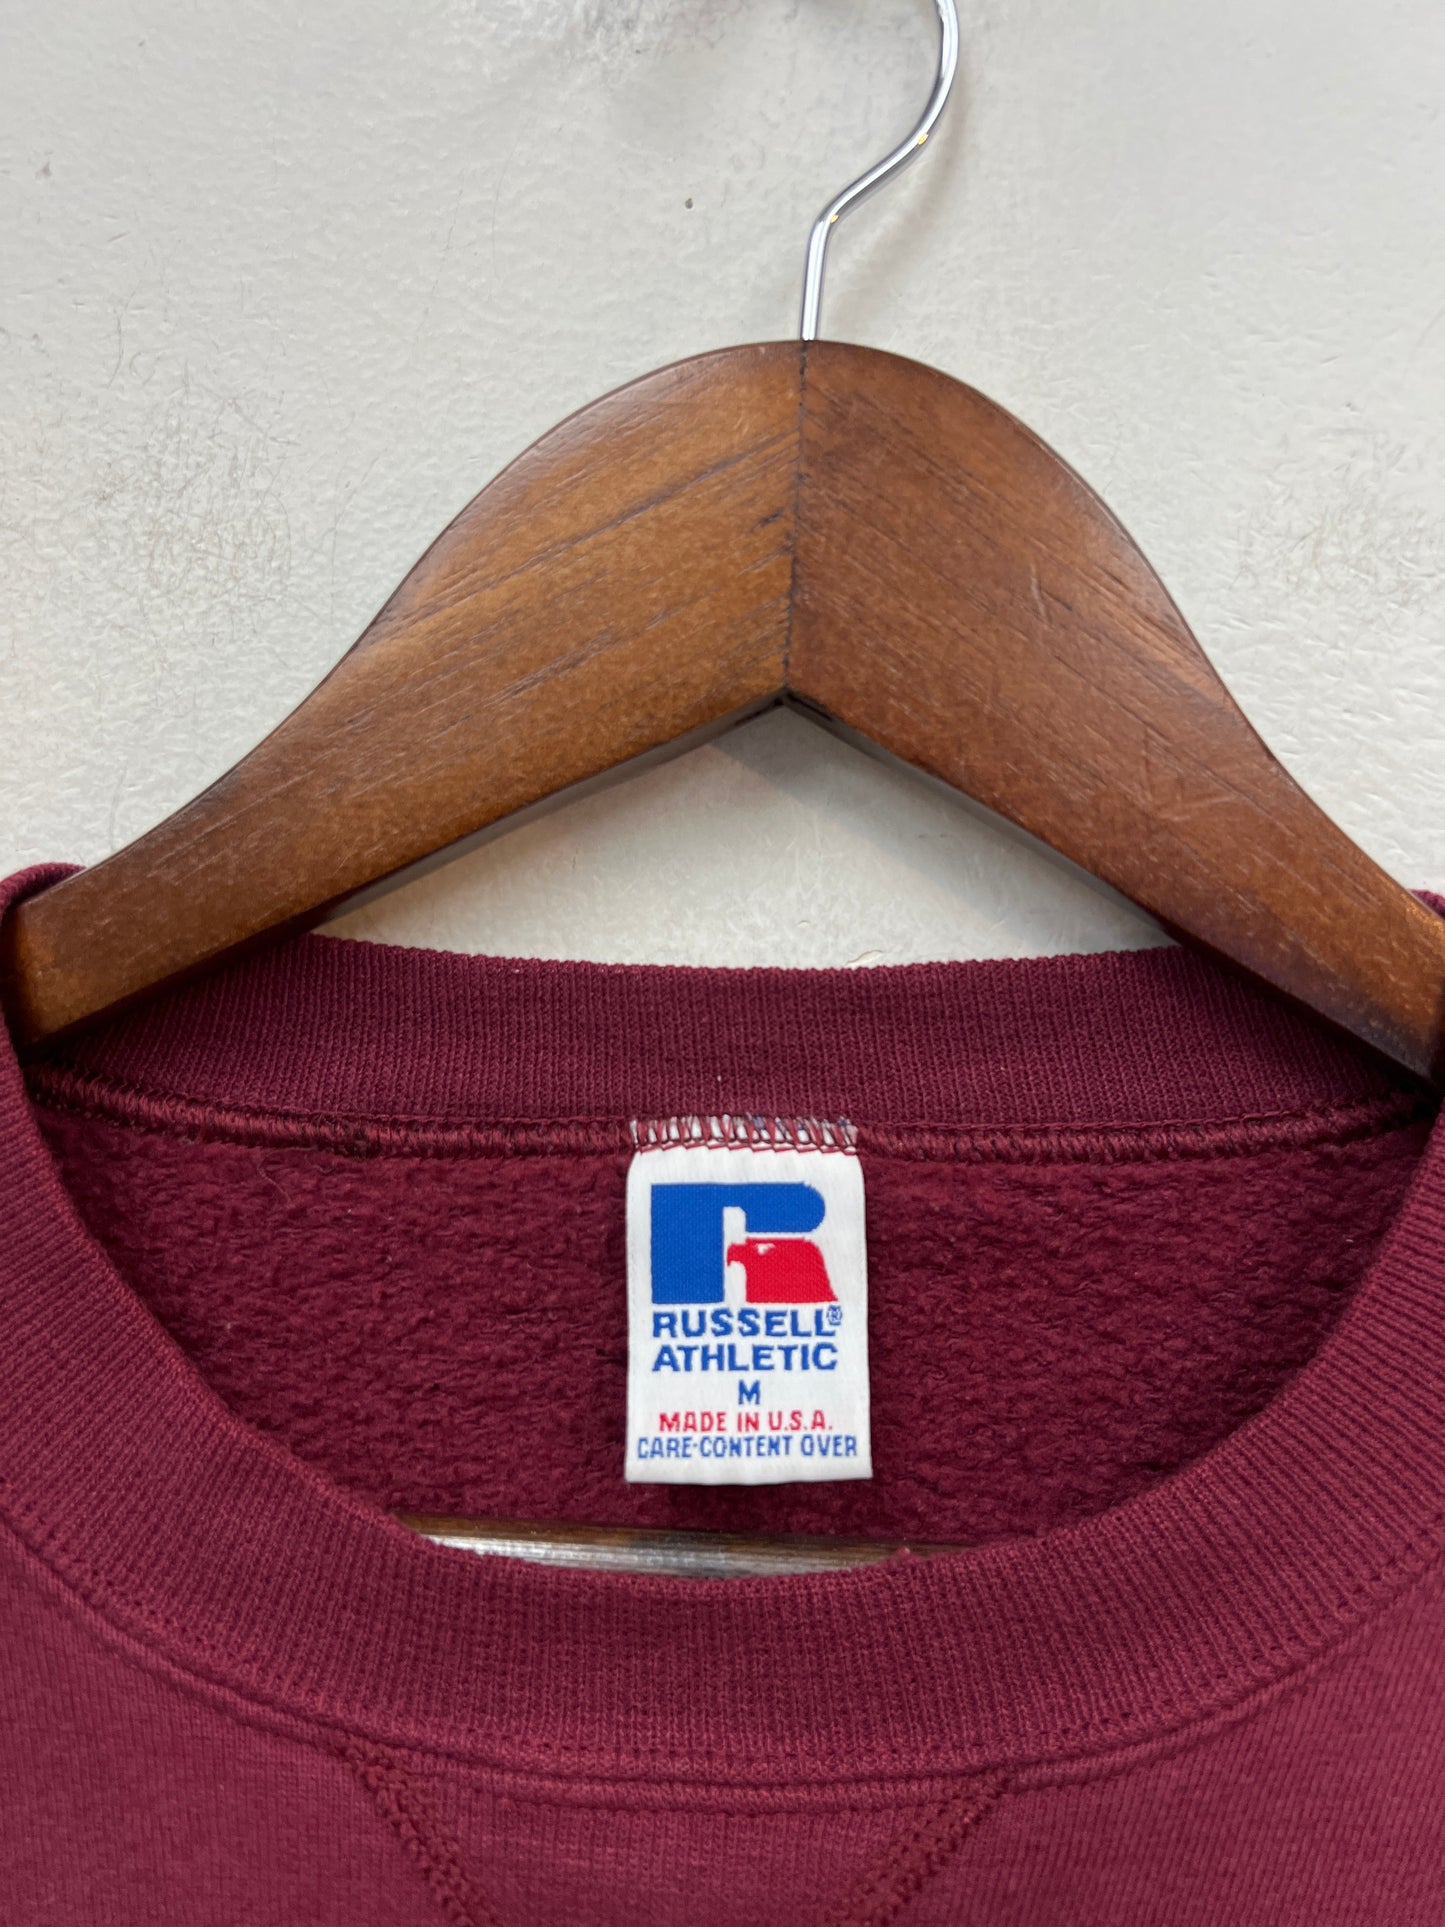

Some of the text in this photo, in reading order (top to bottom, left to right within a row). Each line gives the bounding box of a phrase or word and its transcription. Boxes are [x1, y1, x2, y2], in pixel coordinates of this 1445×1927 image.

[652, 1342, 838, 1372] ATHLETIC
[737, 1379, 761, 1405] M
[659, 1409, 833, 1433] MADE IN U.S.A.
[800, 1434, 858, 1457] OVER
